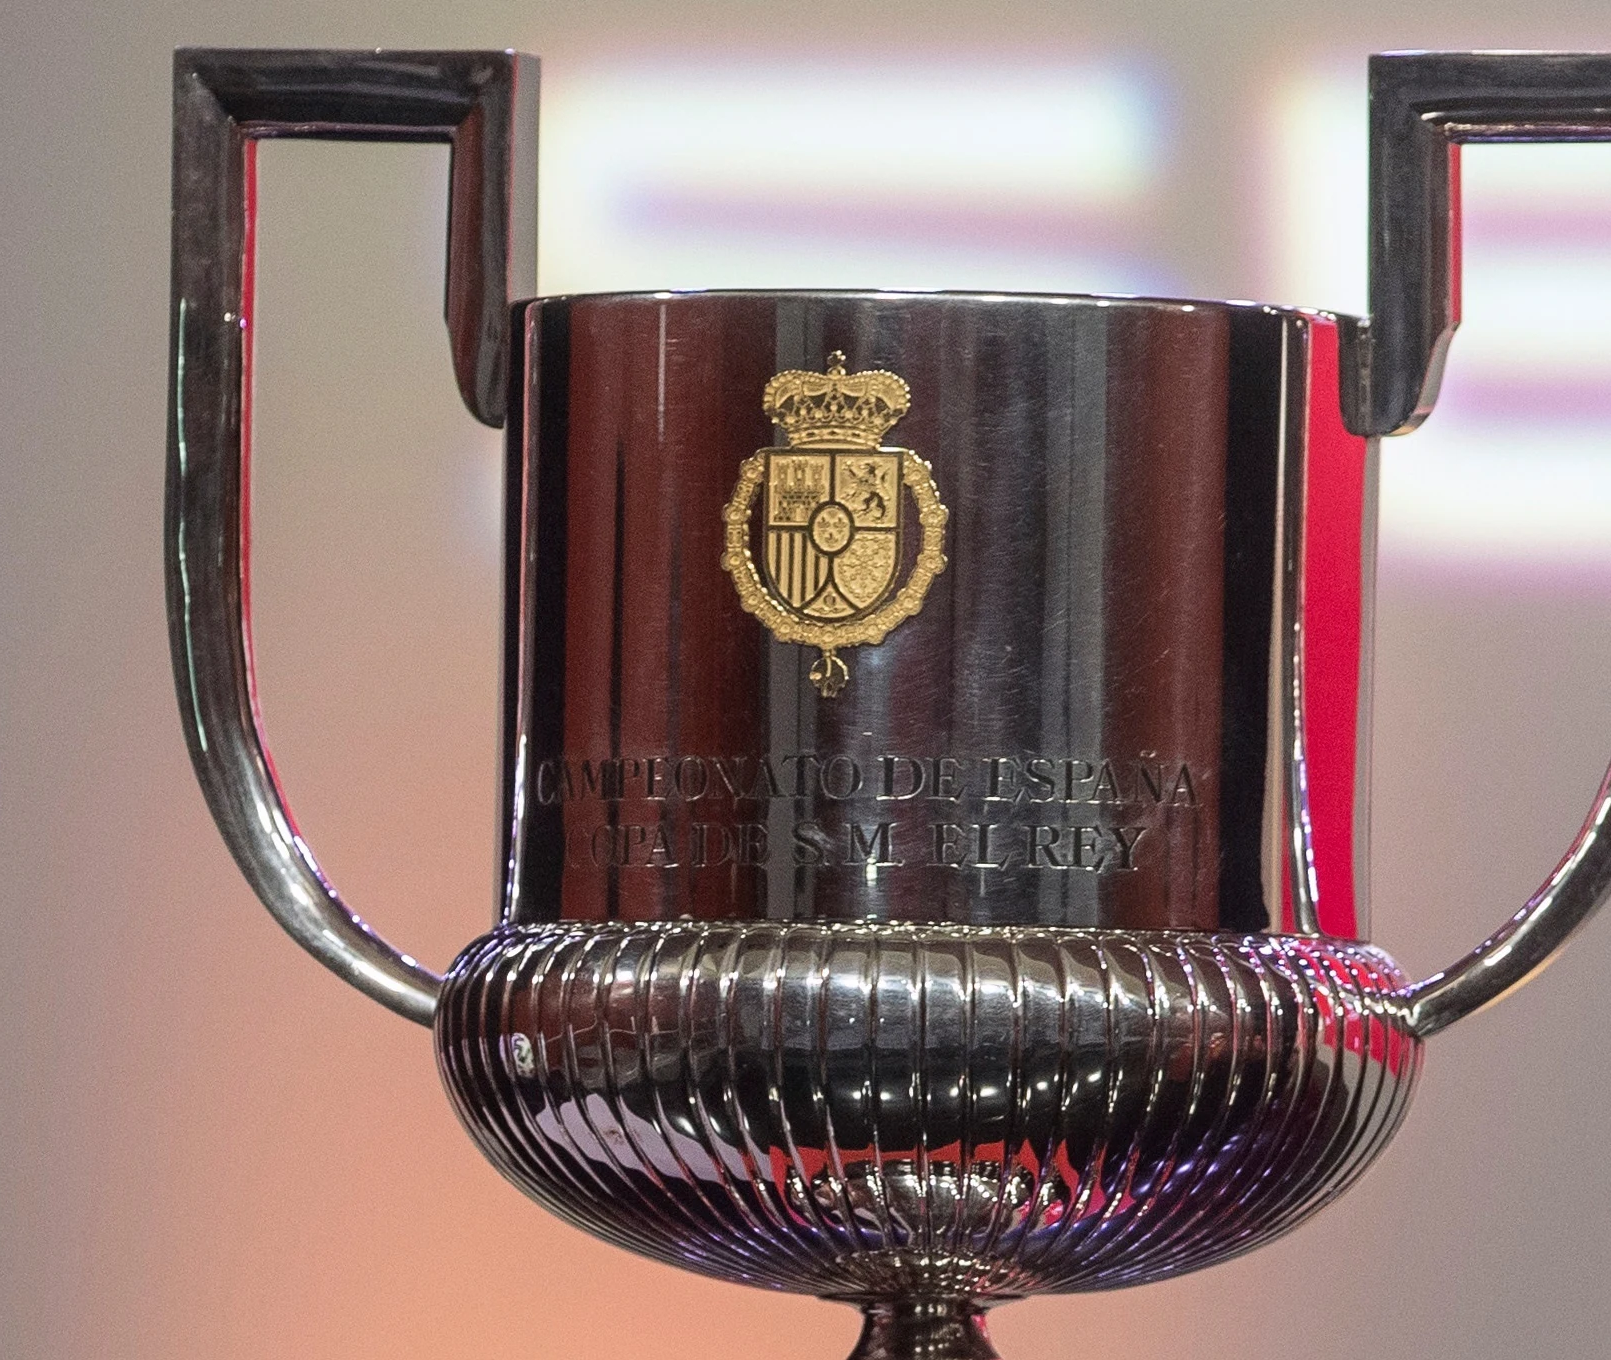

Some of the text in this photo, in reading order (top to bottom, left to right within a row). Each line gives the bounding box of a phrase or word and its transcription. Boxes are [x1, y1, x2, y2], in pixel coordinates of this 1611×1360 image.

[537, 749, 1203, 807] CAMPEONATO DE ESPAÑA
[690, 821, 772, 868] DE
[926, 822, 1015, 870] EL
[1022, 823, 1149, 875] REY
